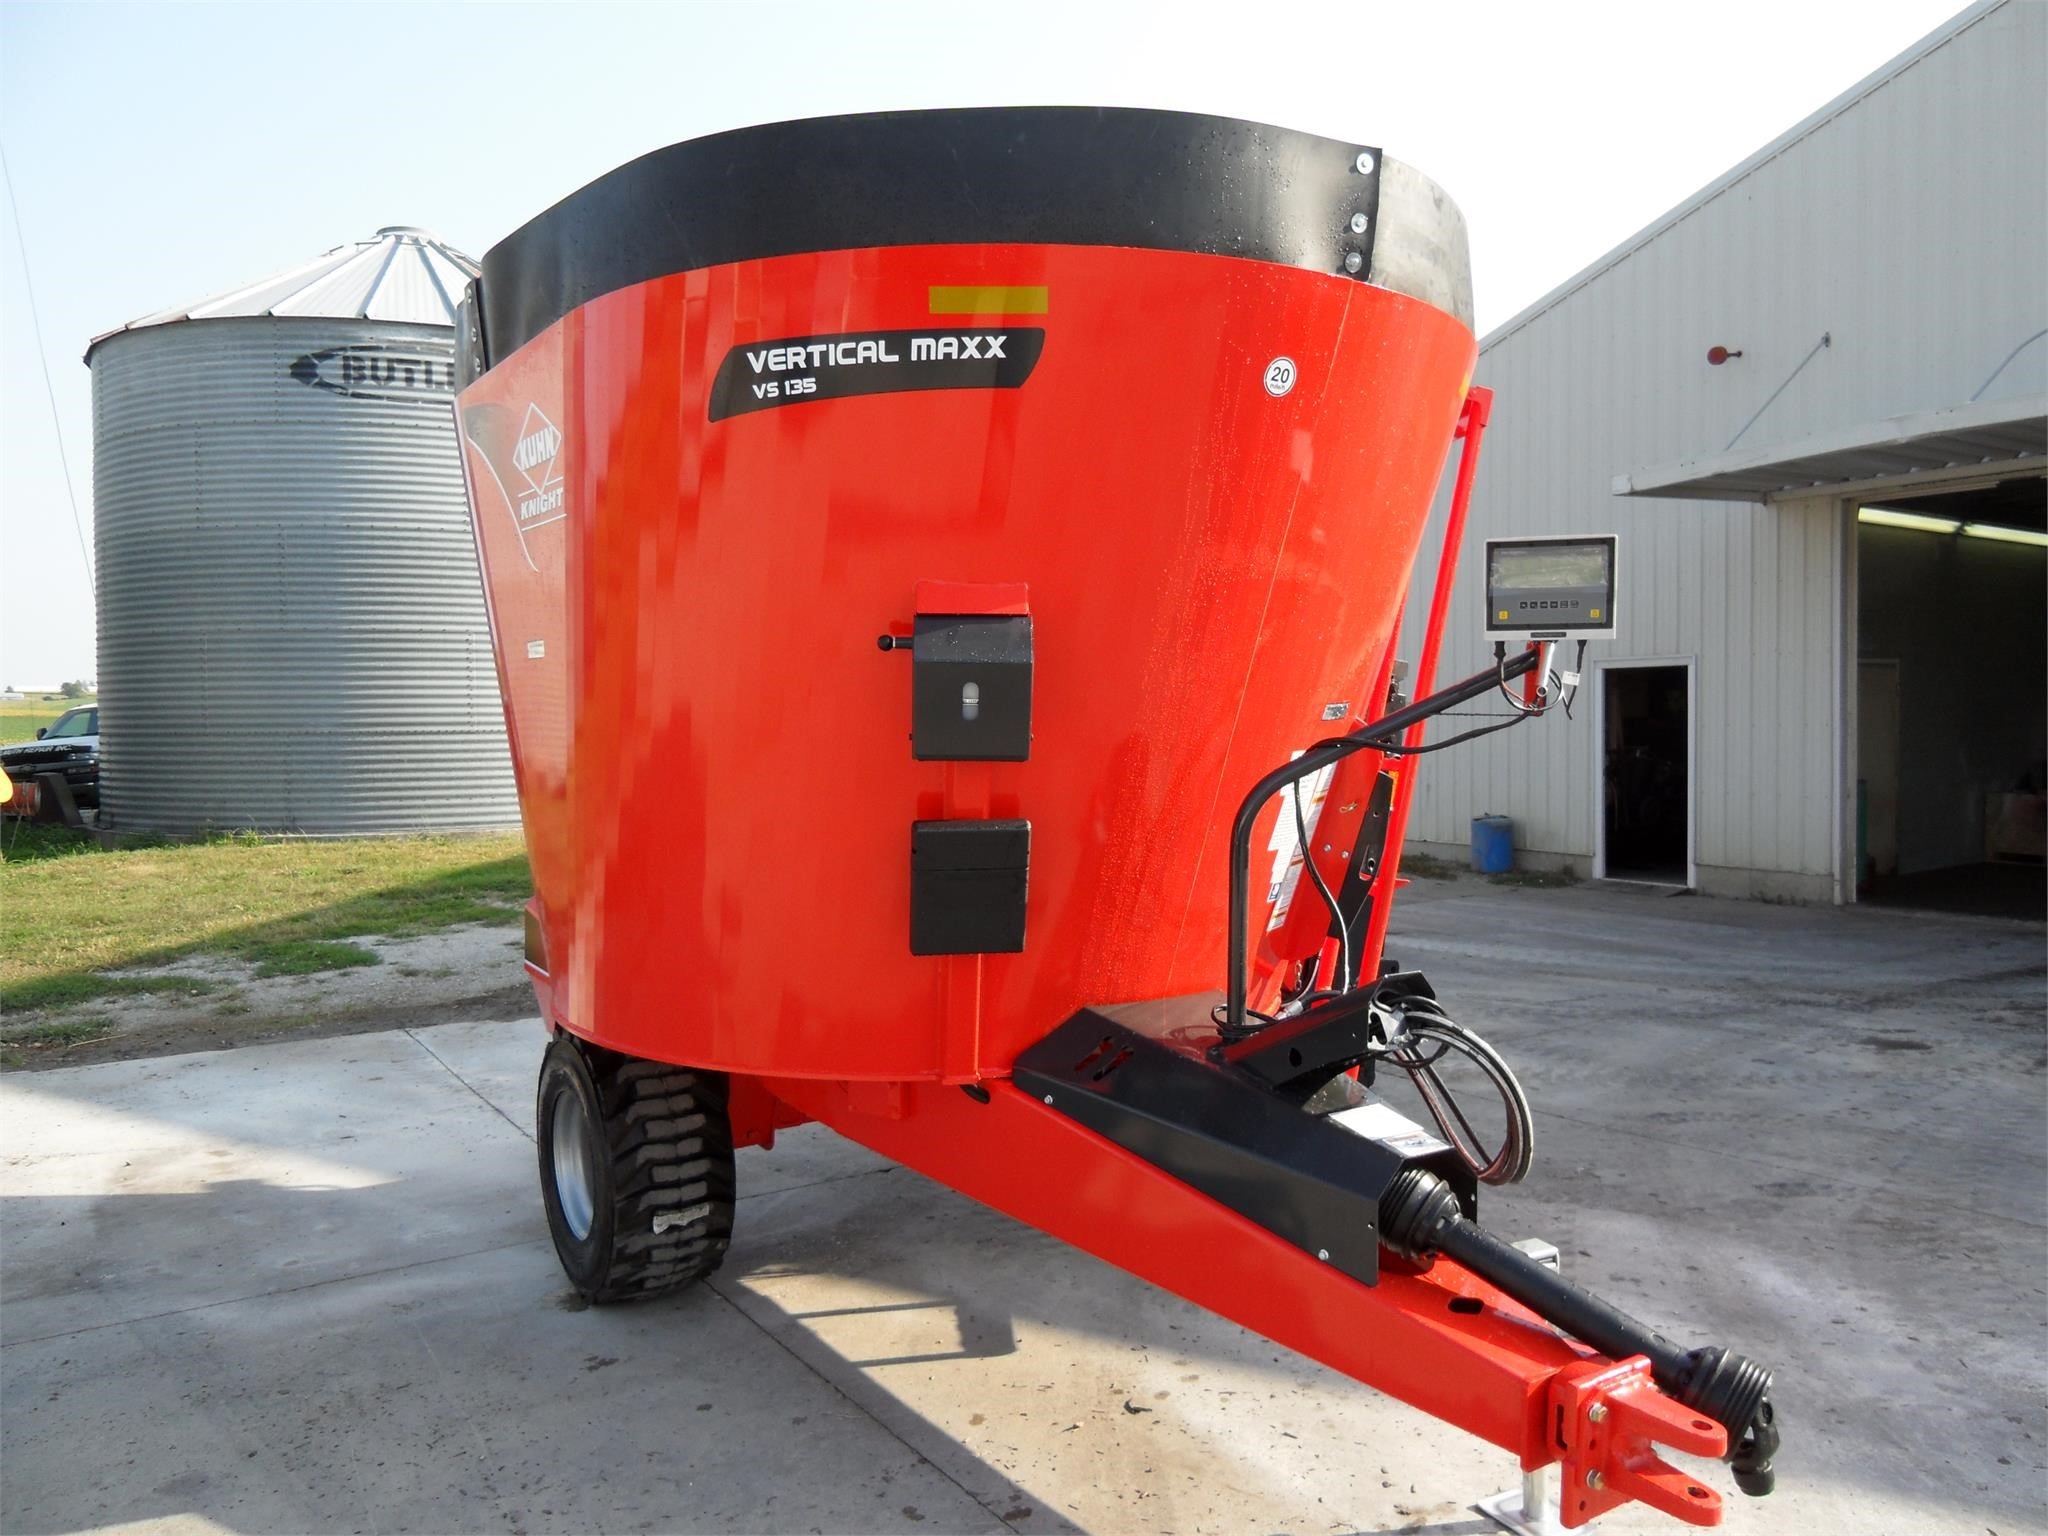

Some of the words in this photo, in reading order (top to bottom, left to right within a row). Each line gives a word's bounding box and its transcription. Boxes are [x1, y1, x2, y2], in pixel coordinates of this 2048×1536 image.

[746, 340, 900, 374] VERTICAL
[910, 335, 1008, 362] MAXX
[752, 381, 780, 400] VS
[784, 377, 817, 396] 135
[1271, 366, 1290, 384] 20
[518, 425, 557, 472] KUHN
[520, 487, 564, 521] KNIGHT
